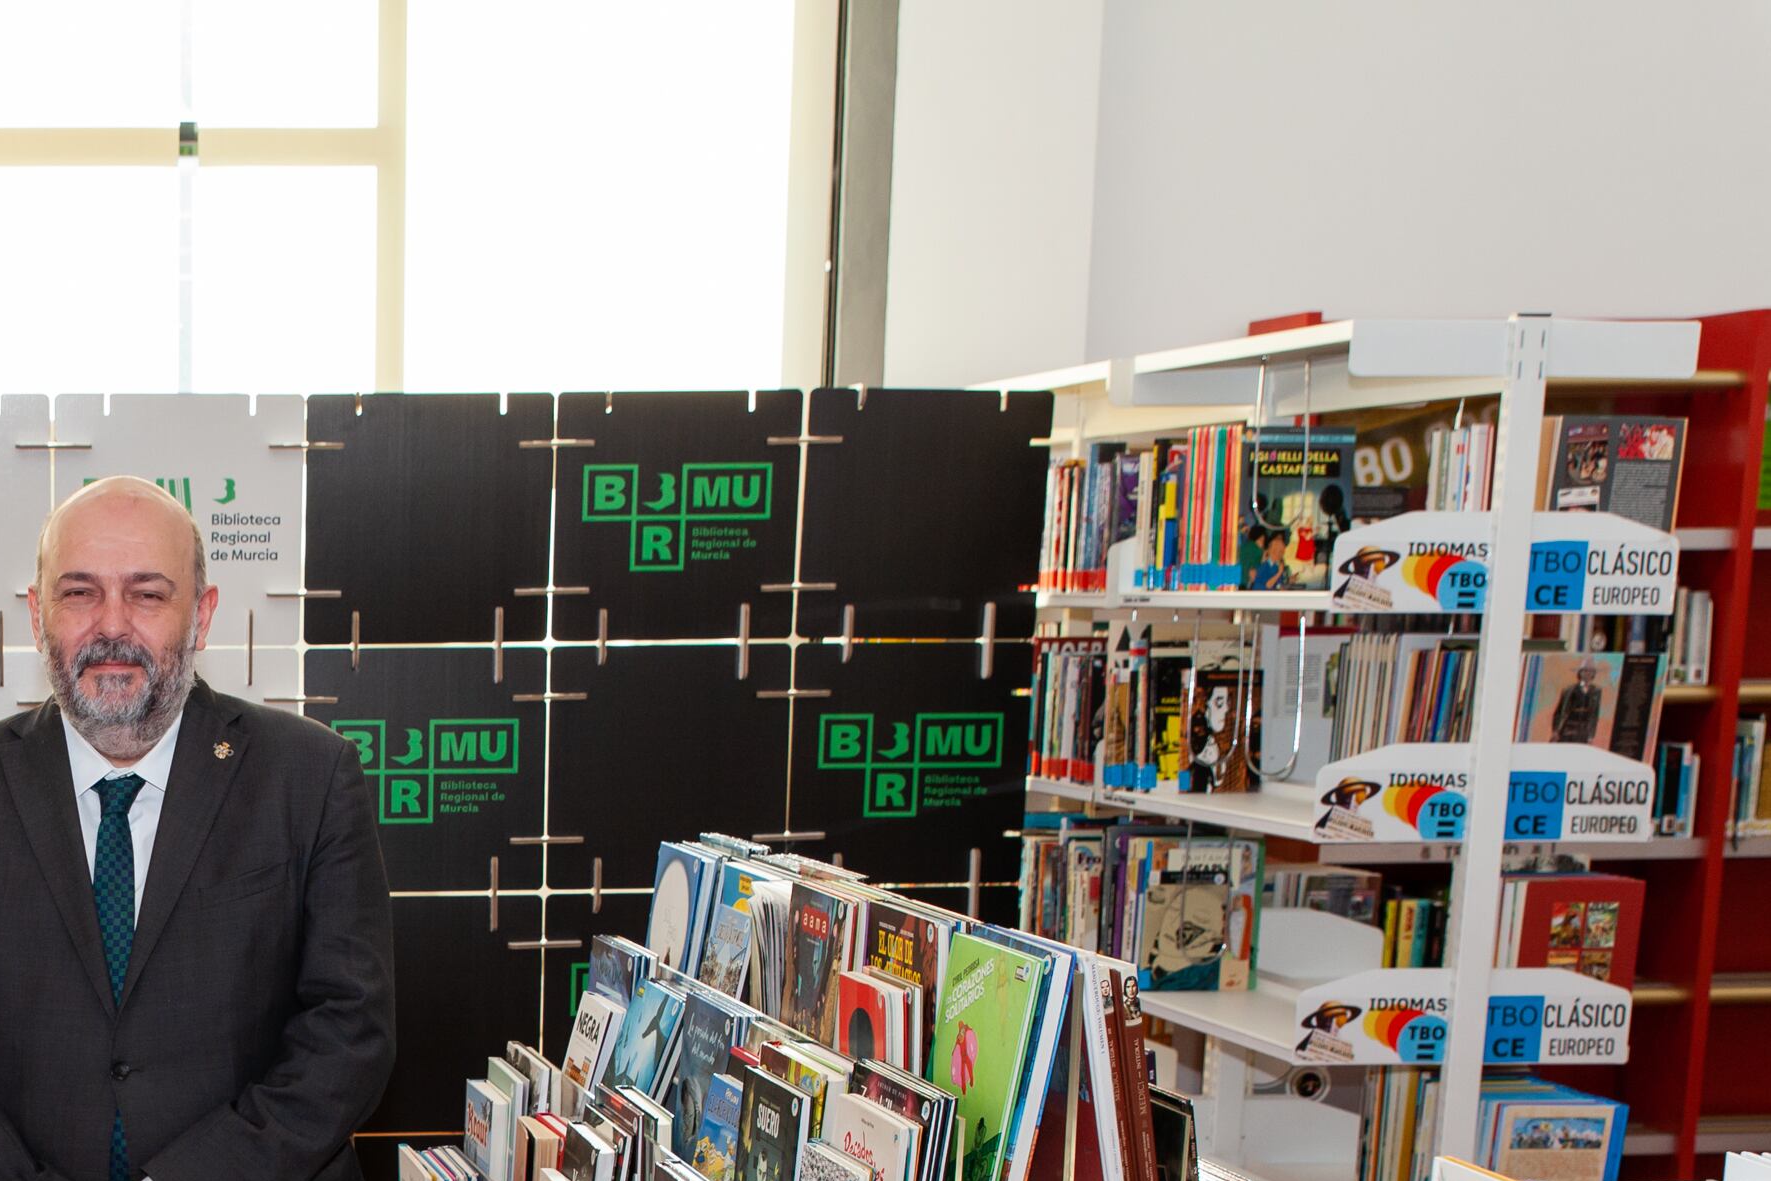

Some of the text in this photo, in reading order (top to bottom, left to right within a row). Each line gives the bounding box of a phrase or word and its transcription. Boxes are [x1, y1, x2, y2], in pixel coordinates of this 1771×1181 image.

[593, 474, 761, 510] B MU
[211, 514, 281, 526] Biblioteca
[211, 531, 271, 545] Regional
[691, 527, 749, 537] Biblioteca
[641, 527, 672, 561] R
[691, 538, 757, 550] Regional de
[1408, 541, 1487, 558] IDIOMAS
[211, 549, 278, 561] de Murcia
[691, 550, 731, 561] Murcia
[1588, 544, 1672, 576] CLÁSICO
[1449, 572, 1486, 588] TBO
[1535, 586, 1568, 606] CE
[1593, 587, 1660, 606] EUROPEO
[440, 731, 507, 761] MU
[829, 724, 992, 759] B MU
[440, 781, 497, 790] Biblioteca
[924, 774, 980, 785] Biblioteca
[1389, 774, 1467, 789] IDIOMAS
[391, 780, 422, 813] R
[440, 791, 506, 803] Regional de
[875, 774, 905, 807] R
[924, 786, 987, 797] Regional de
[1565, 775, 1648, 806] CLÁSICO
[440, 803, 479, 814] Murcia
[924, 797, 962, 809] Murcia
[1428, 803, 1466, 818] TBO
[1514, 817, 1547, 836] CE
[1570, 815, 1637, 835] EUROPEO
[802, 911, 828, 934] aama
[951, 959, 996, 1002] CORAZONES
[945, 983, 985, 1025] SOLITARIOS
[1369, 998, 1448, 1013] IDIOMAS
[1543, 999, 1625, 1030] CLÁSICO
[577, 1010, 601, 1045] NEGRA
[1408, 1027, 1446, 1043] TBO
[1492, 1037, 1526, 1058] CE
[1548, 1036, 1614, 1057] EUROPEO
[1138, 1080, 1148, 1115] MEDICI
[756, 1103, 781, 1139] SUERO
